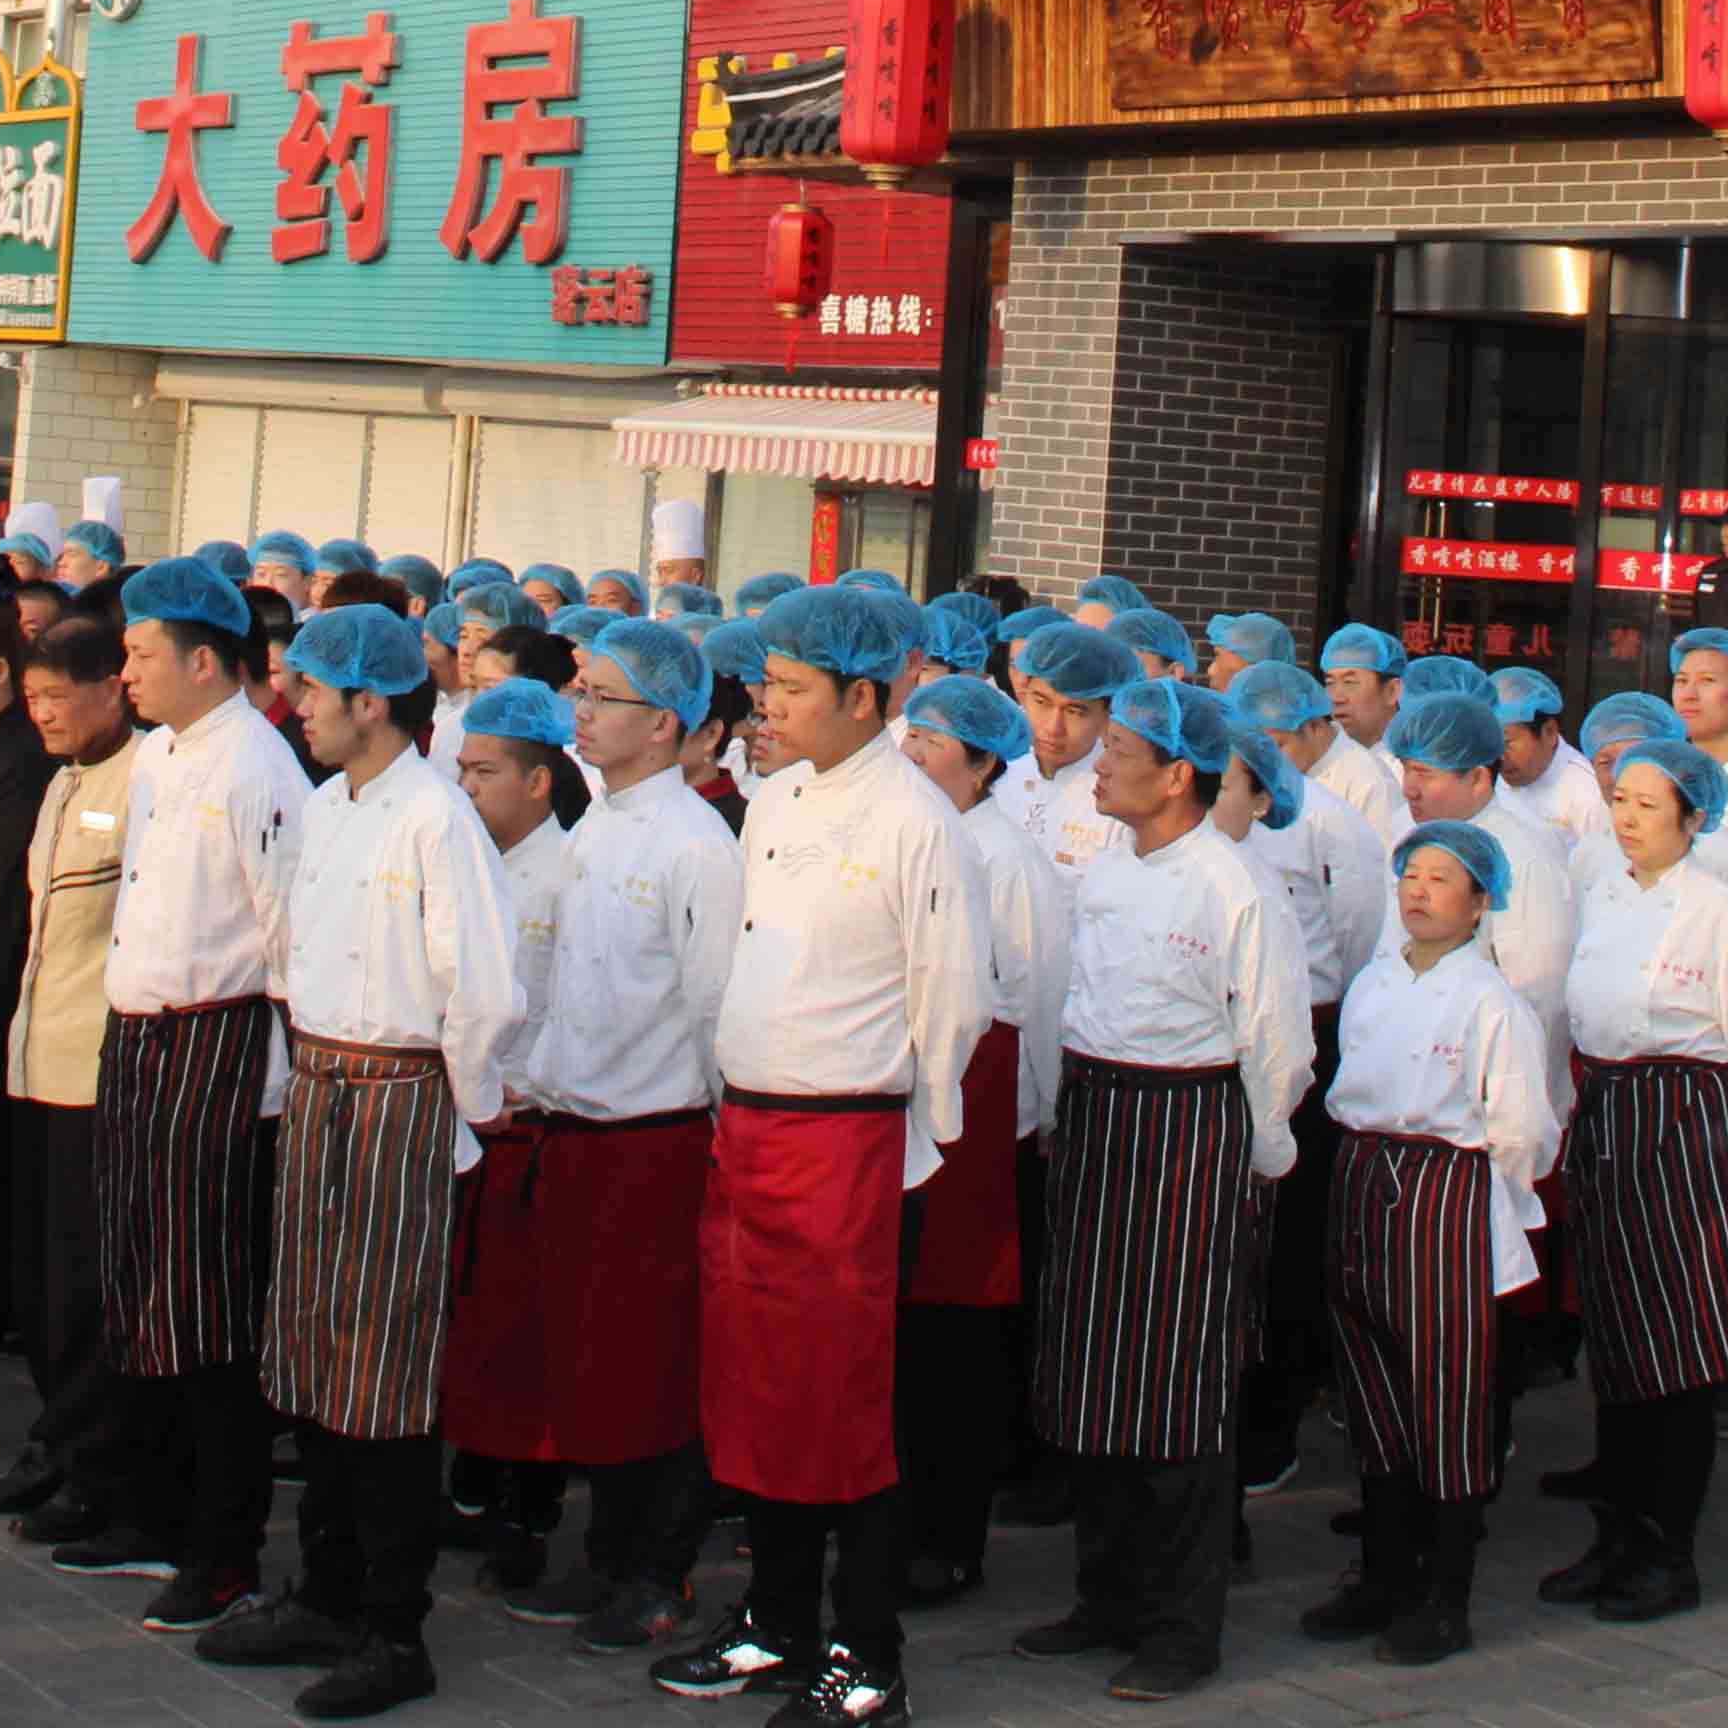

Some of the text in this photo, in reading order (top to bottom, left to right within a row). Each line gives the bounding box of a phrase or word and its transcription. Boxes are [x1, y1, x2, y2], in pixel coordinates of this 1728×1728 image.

[819, 293, 934, 336] 喜糖热线:
[1409, 544, 1522, 573] 香喷喷酒楼
